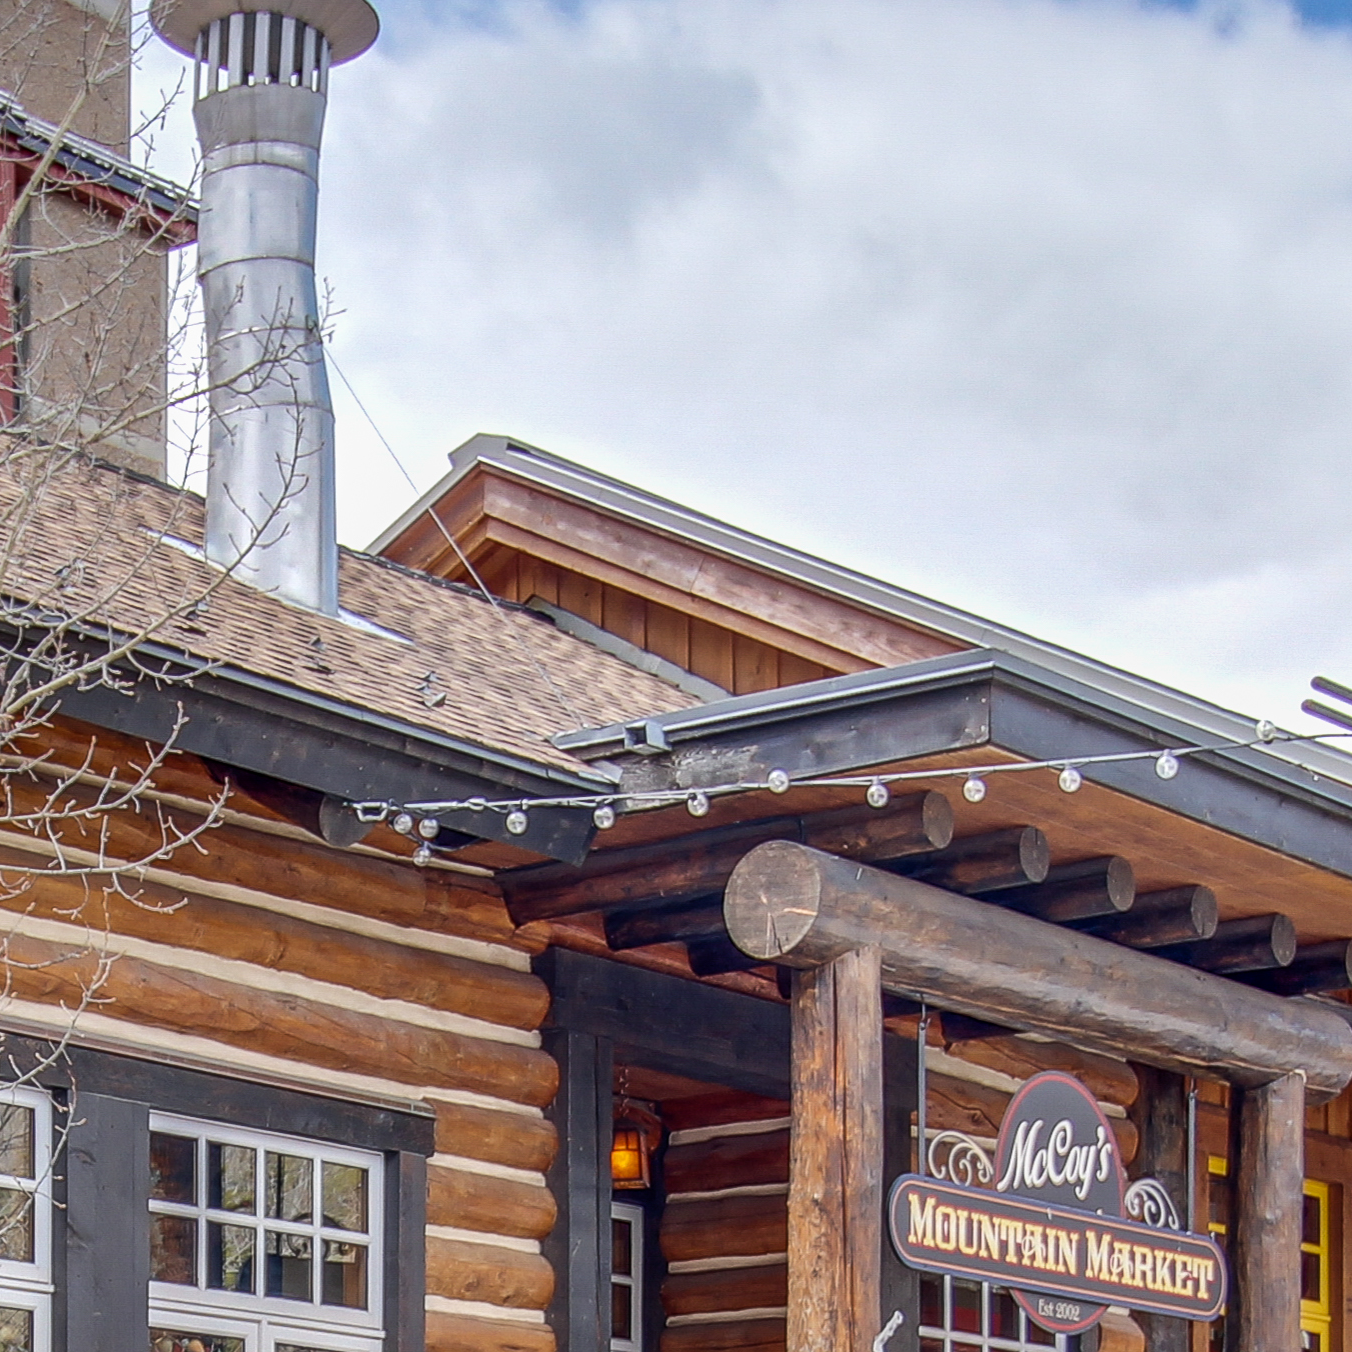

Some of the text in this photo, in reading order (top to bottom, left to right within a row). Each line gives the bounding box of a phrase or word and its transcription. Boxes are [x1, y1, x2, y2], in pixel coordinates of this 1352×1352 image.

[997, 1120, 1112, 1200] McCoy's
[907, 1193, 1215, 1300] MOUNTAIN MARKET
[1038, 1299, 1080, 1321] Est 2002
